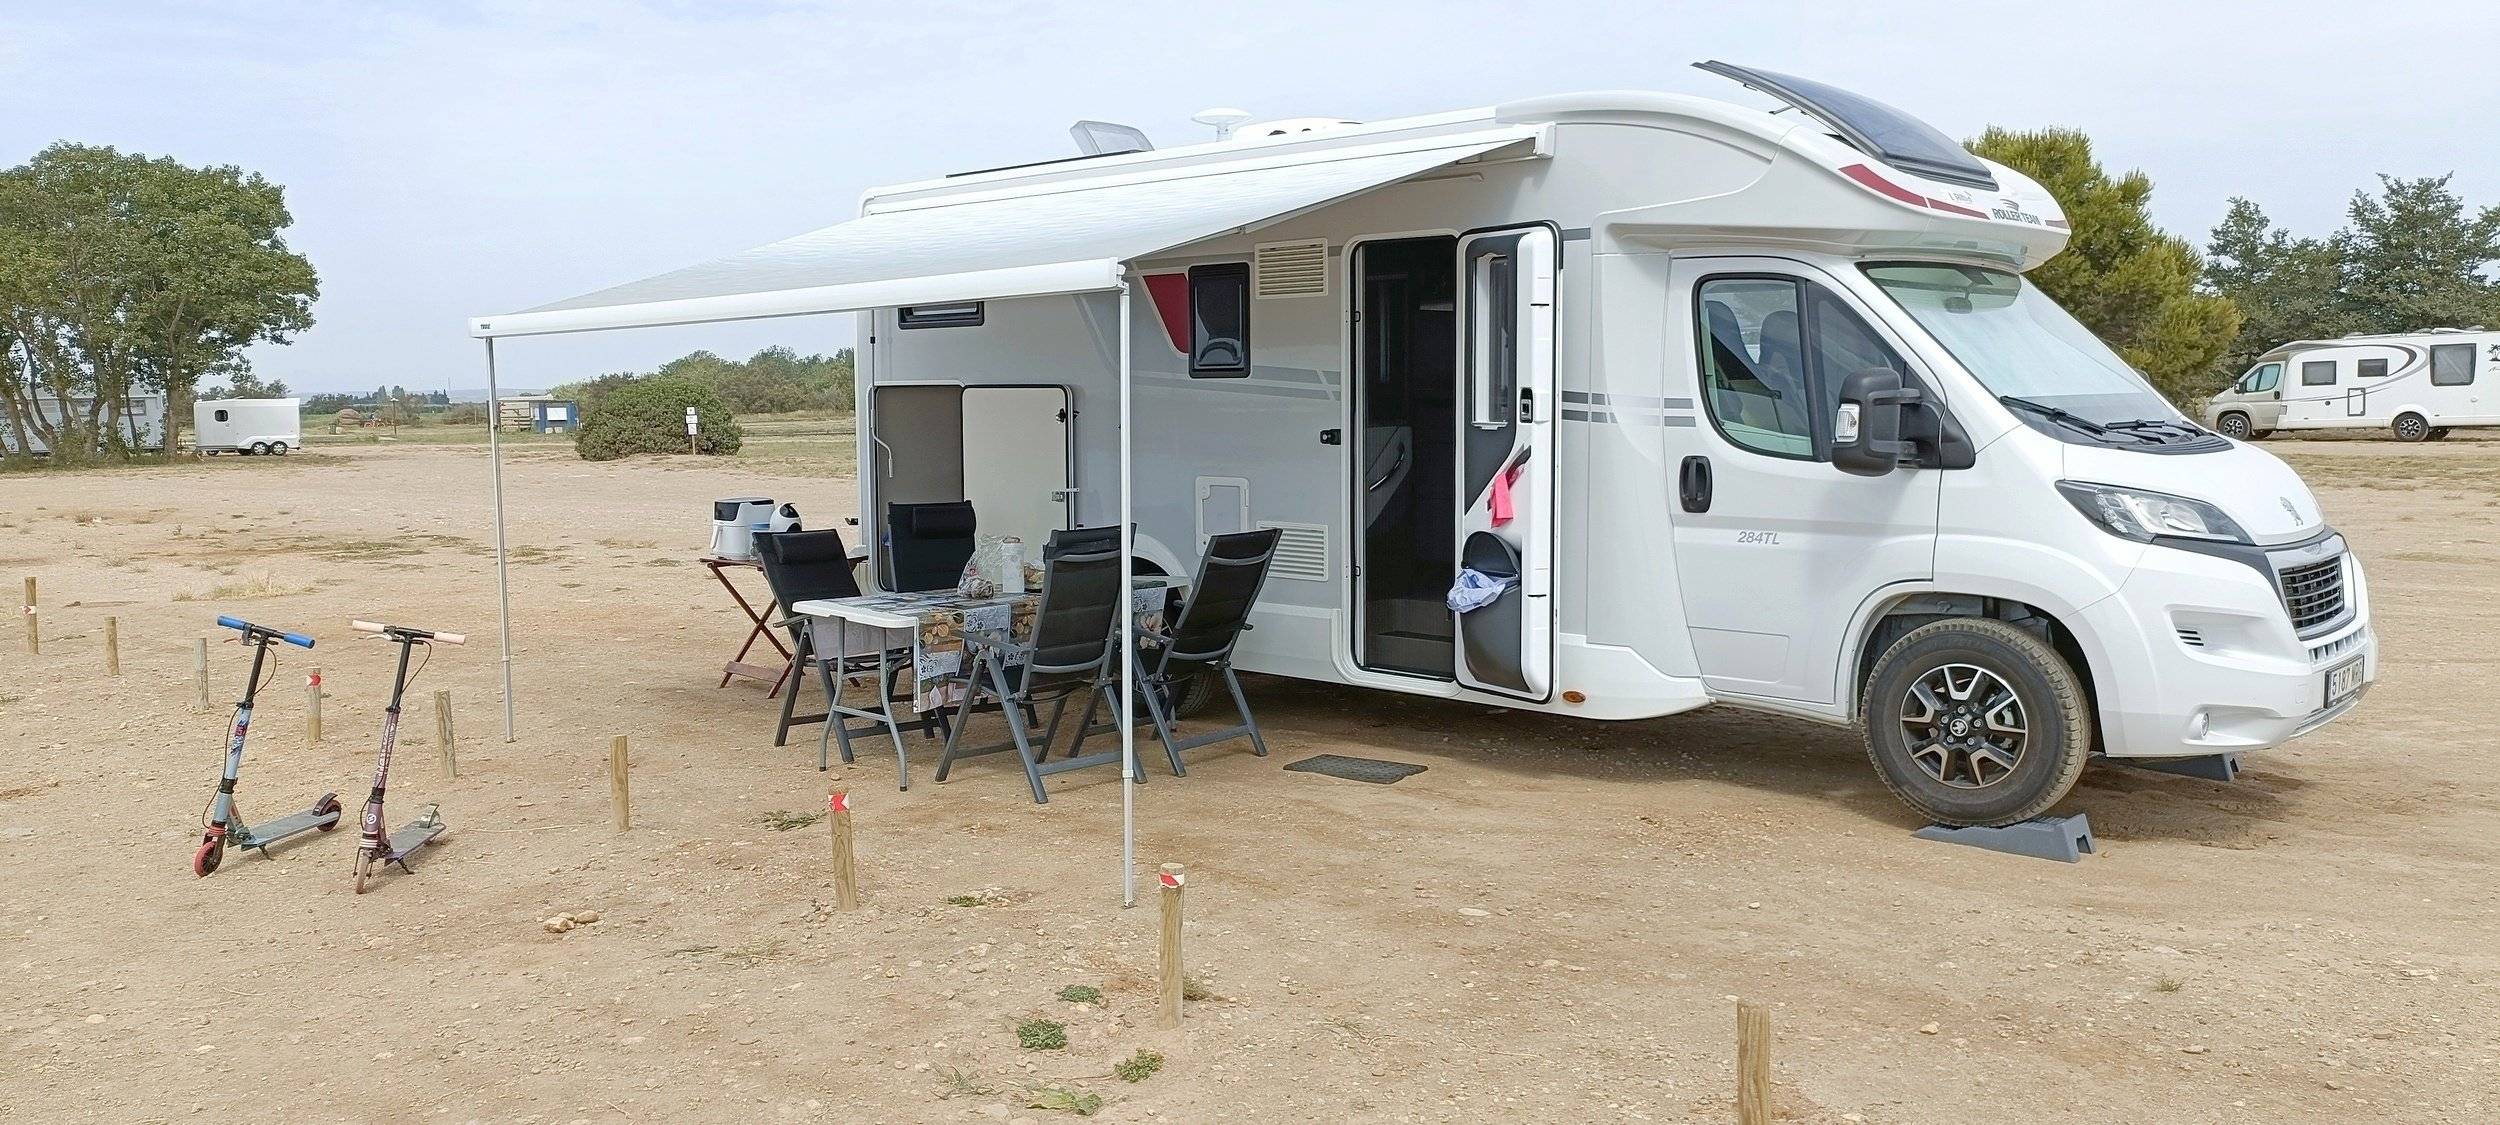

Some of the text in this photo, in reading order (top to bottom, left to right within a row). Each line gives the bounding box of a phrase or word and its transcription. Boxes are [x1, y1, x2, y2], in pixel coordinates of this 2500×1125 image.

[1992, 208, 2041, 225] ROLLER TEAM
[1737, 531, 1780, 545] 284TL
